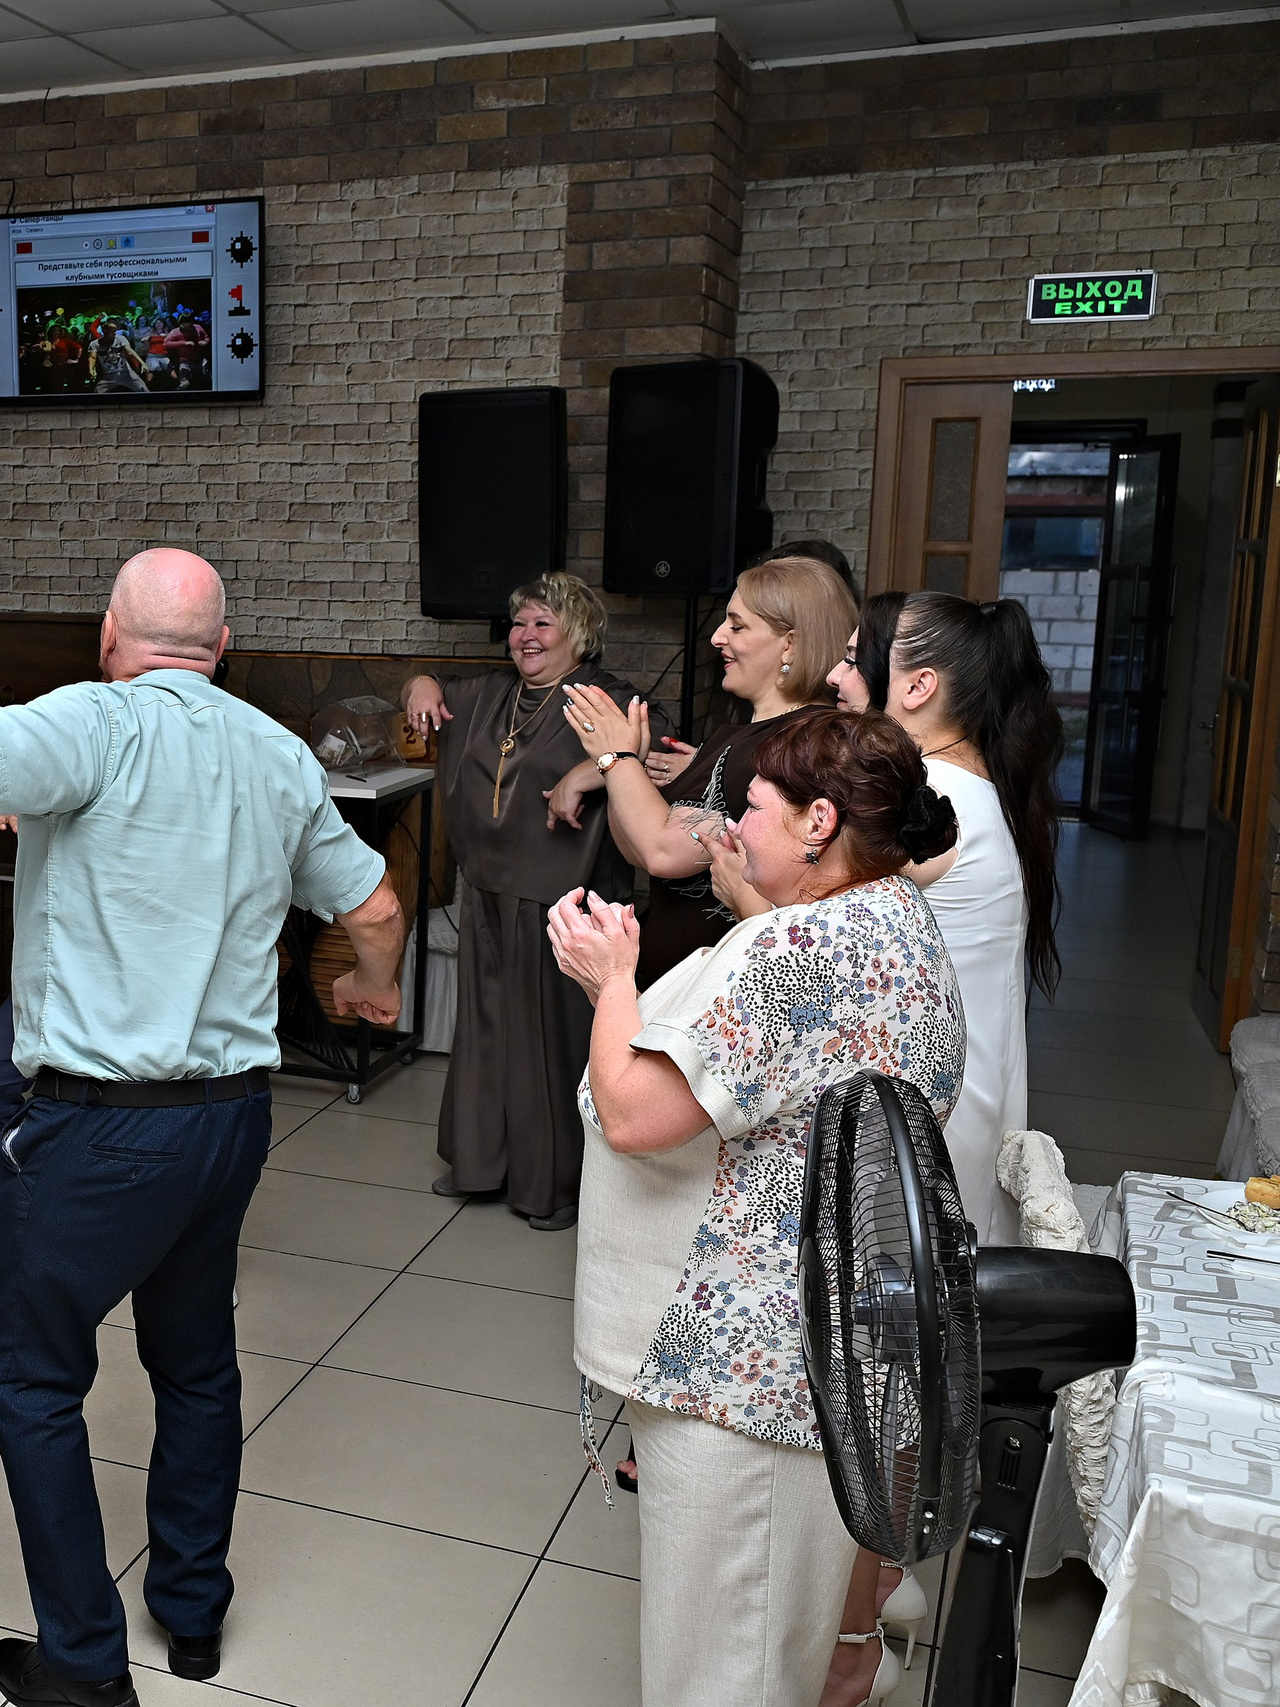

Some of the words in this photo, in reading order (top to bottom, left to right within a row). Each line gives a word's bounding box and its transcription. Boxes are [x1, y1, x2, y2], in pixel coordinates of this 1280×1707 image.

[38, 262, 85, 272] Представьте
[85, 260, 103, 269] себя
[104, 256, 188, 269] профессиональными
[65, 272, 105, 283] клубными
[106, 269, 159, 281] тусовщиками
[1041, 279, 1144, 300] ВЫХОД
[1054, 300, 1128, 315] EXIT
[402, 725, 417, 745] 2
